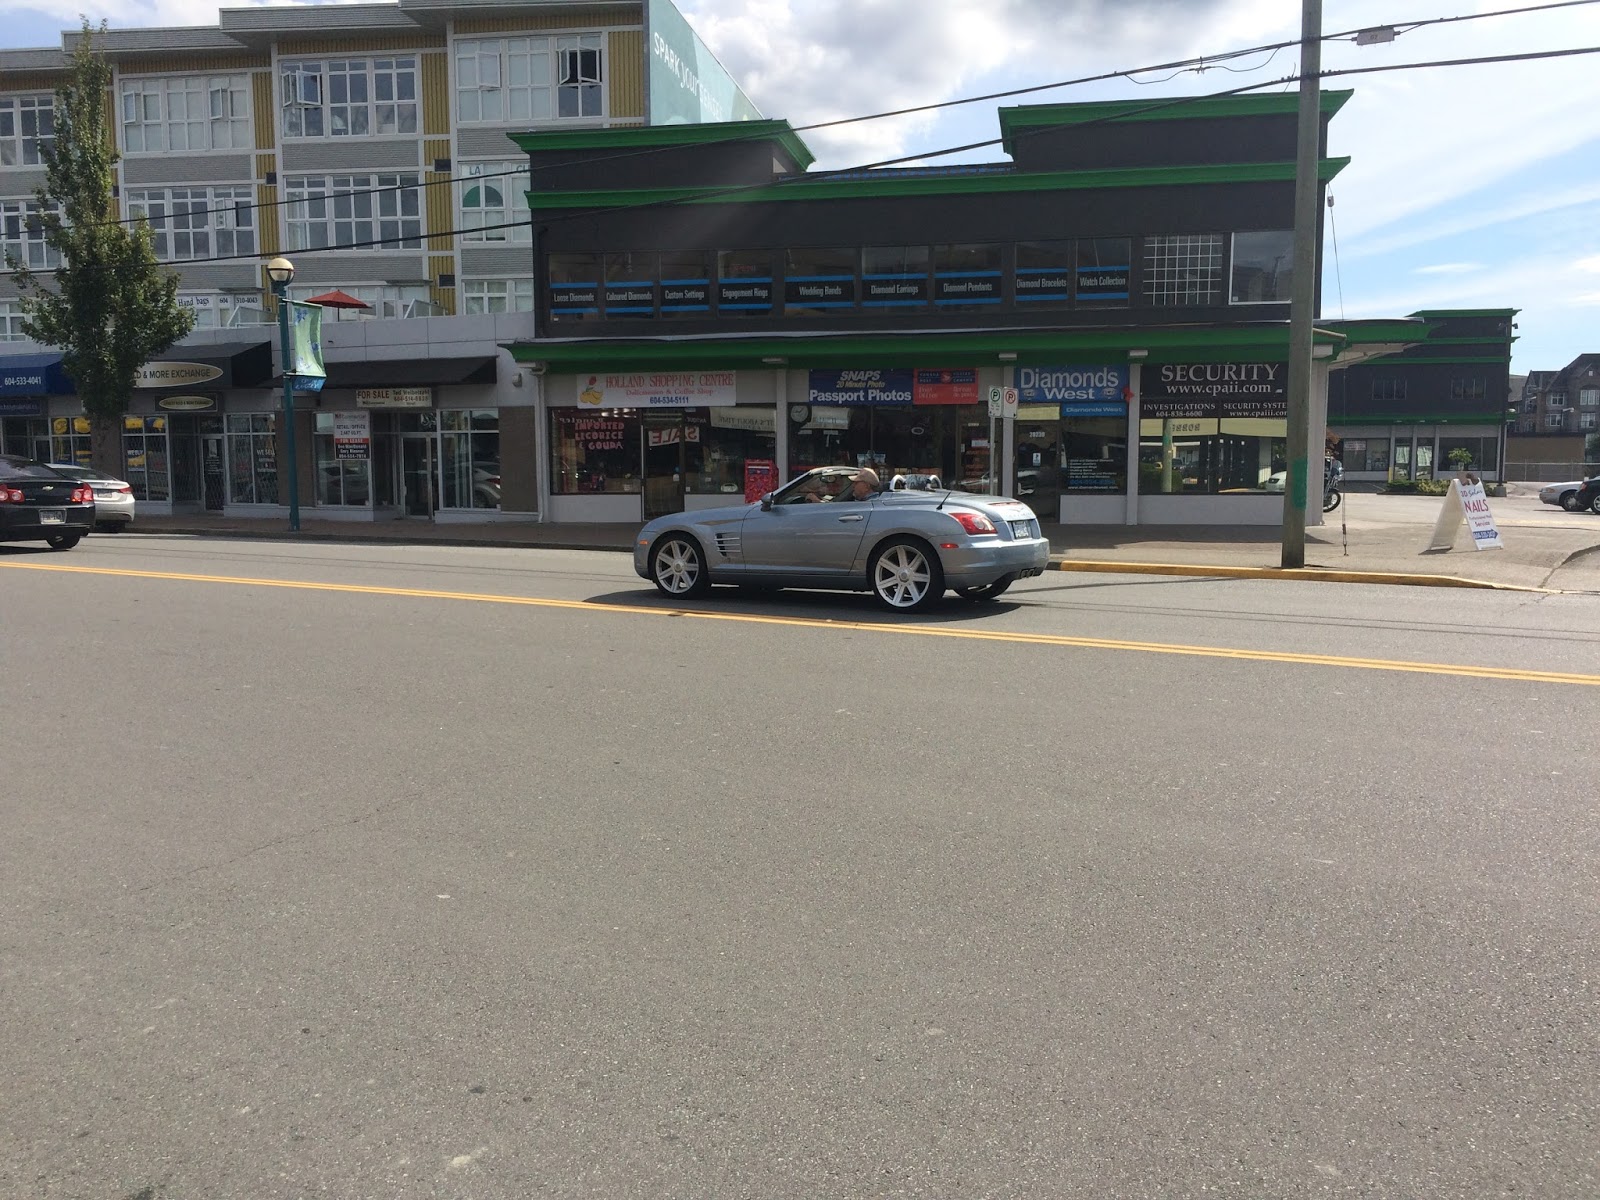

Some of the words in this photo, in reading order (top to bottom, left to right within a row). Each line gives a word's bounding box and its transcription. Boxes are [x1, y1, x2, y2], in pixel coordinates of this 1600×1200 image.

[654, 32, 680, 78] SPARK
[680, 62, 700, 97] your
[469, 166, 481, 176] LA
[1016, 279, 1041, 288] Diamond
[1041, 278, 1067, 288] Bracelets
[1080, 277, 1098, 286] Watch
[1098, 276, 1126, 286] Collection
[799, 286, 824, 297] Wedding
[825, 286, 842, 296] Bands
[870, 284, 896, 295] Diamond
[896, 284, 919, 296] Earrings
[943, 283, 967, 293] Diamond
[968, 282, 993, 292] Pendants
[553, 293, 569, 302] Loose
[569, 292, 594, 302] Diamonds
[606, 291, 628, 301] Coloured
[628, 291, 652, 301] Diamonds
[665, 290, 684, 300] Custom
[684, 290, 705, 301] Settings
[722, 288, 753, 300] Engagement
[754, 288, 768, 299] Rings
[178, 299, 194, 307] Hand
[195, 297, 210, 307] bags
[143, 371, 148, 379] &
[149, 370, 170, 379] MORE
[171, 369, 211, 378] EXCHANGE
[839, 370, 881, 381] SNAPS
[1020, 367, 1119, 388] Diamonds
[1161, 364, 1279, 382] SECURITY
[4, 376, 42, 386] 604-533-4041
[606, 376, 645, 388] HOLLAND
[649, 375, 695, 387] SHOPPING
[699, 373, 734, 386] CENTRE
[845, 380, 866, 388] Minute
[867, 380, 886, 388] Photo
[697, 388, 714, 396] Shop
[1043, 387, 1095, 400] West
[1166, 381, 1271, 396] www.cpaii.com
[357, 390, 371, 399] FOR
[372, 390, 390, 399] SALE
[809, 389, 865, 404] Passport
[868, 388, 912, 401] Photos
[649, 396, 689, 404] 604-534-5111
[1143, 403, 1216, 411] INVESTIGATIONS
[575, 422, 625, 430] IMPORTED
[575, 431, 624, 441] LICORICE
[588, 441, 624, 450] GOUDA
[1463, 499, 1489, 513] NAILS
